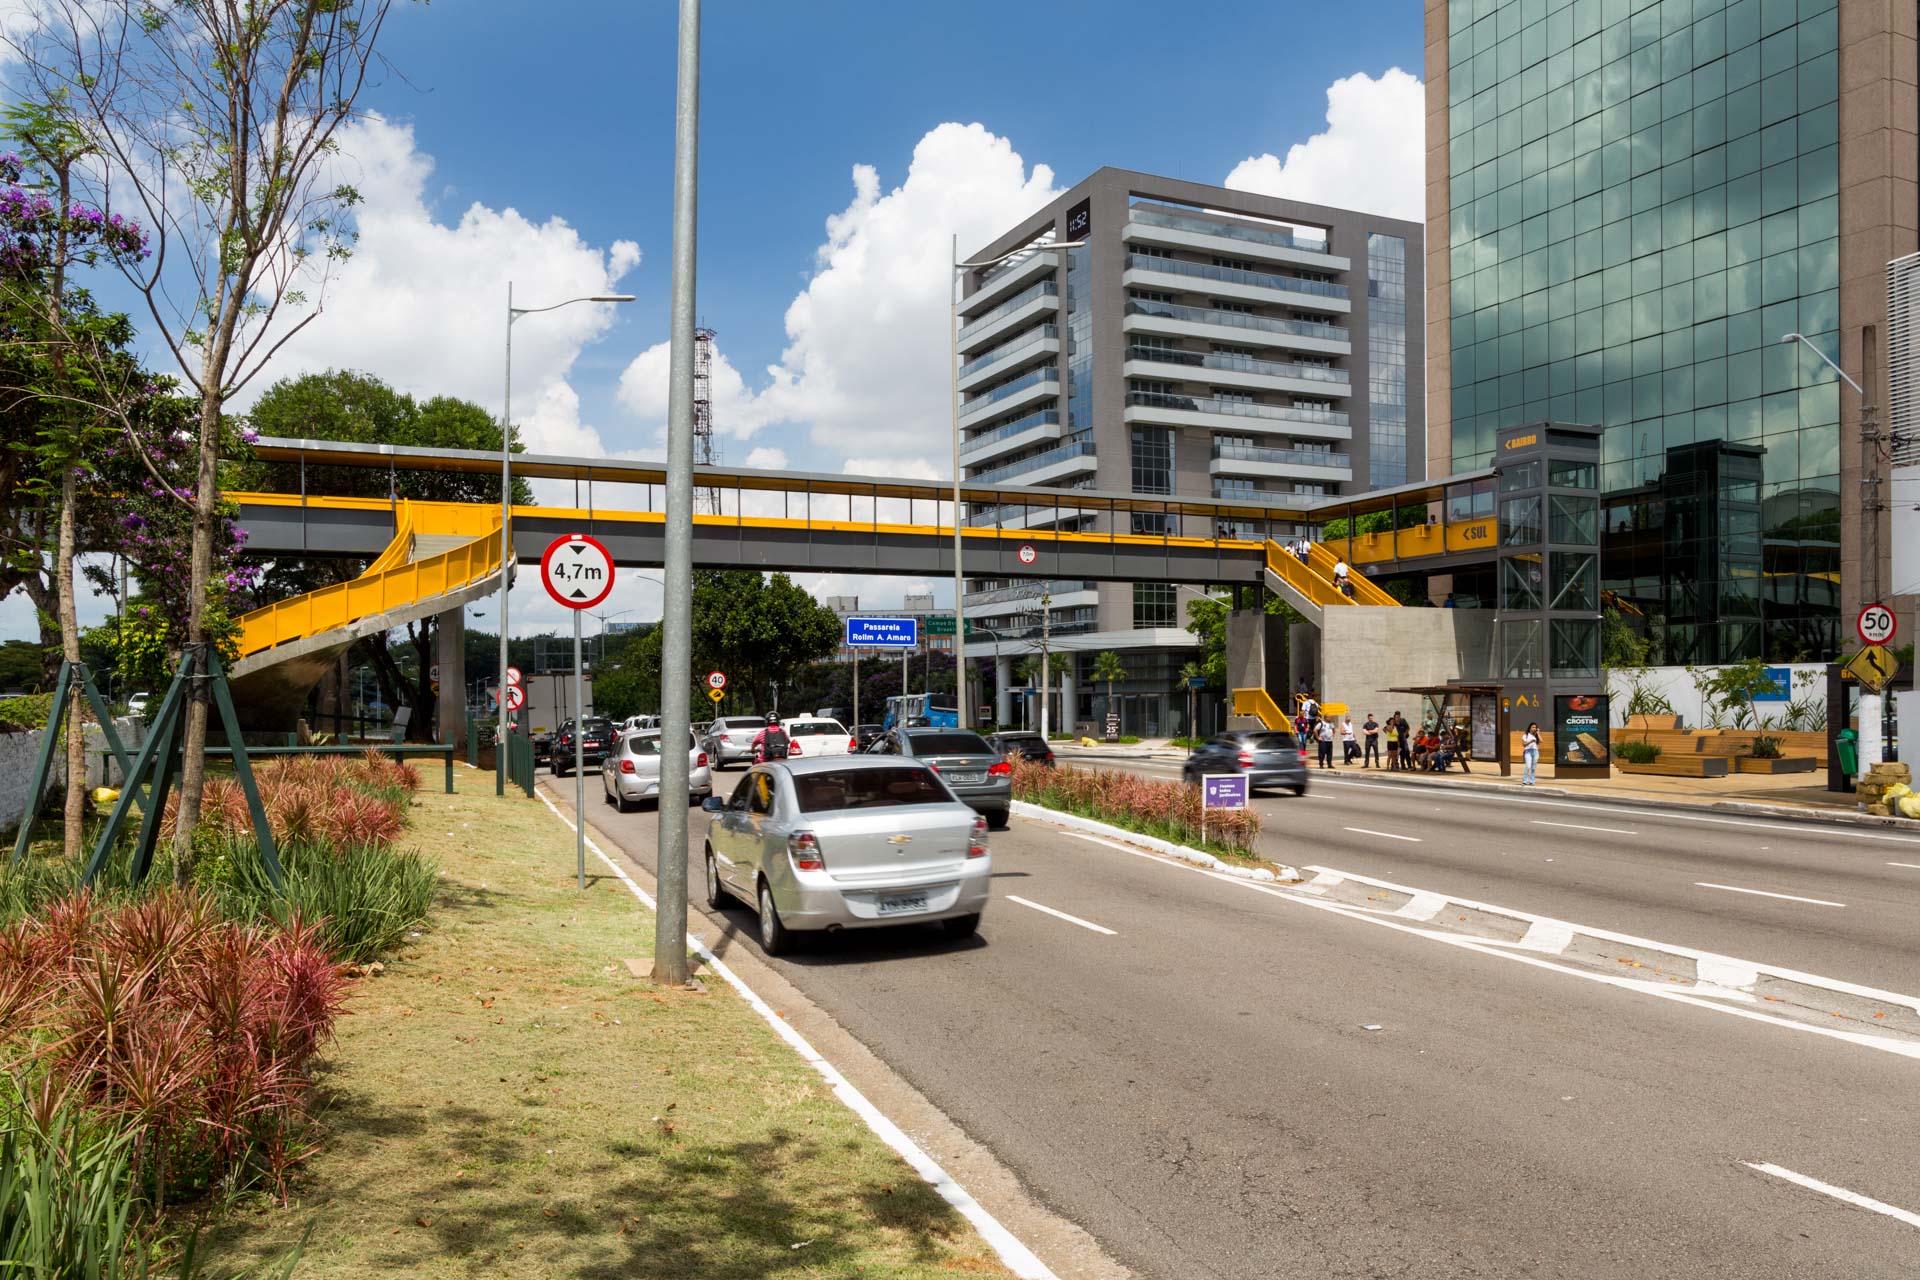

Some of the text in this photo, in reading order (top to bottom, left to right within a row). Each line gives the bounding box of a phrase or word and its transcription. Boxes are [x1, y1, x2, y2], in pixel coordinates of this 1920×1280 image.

[1069, 211, 1087, 232] 11:52
[1471, 525, 1487, 539] SUL
[554, 562, 602, 582] 4,7m
[863, 623, 900, 631] Passarela
[1864, 612, 1890, 631] 50
[852, 633, 874, 641] Rolim
[886, 633, 911, 641] Amaro
[711, 676, 723, 684] 40
